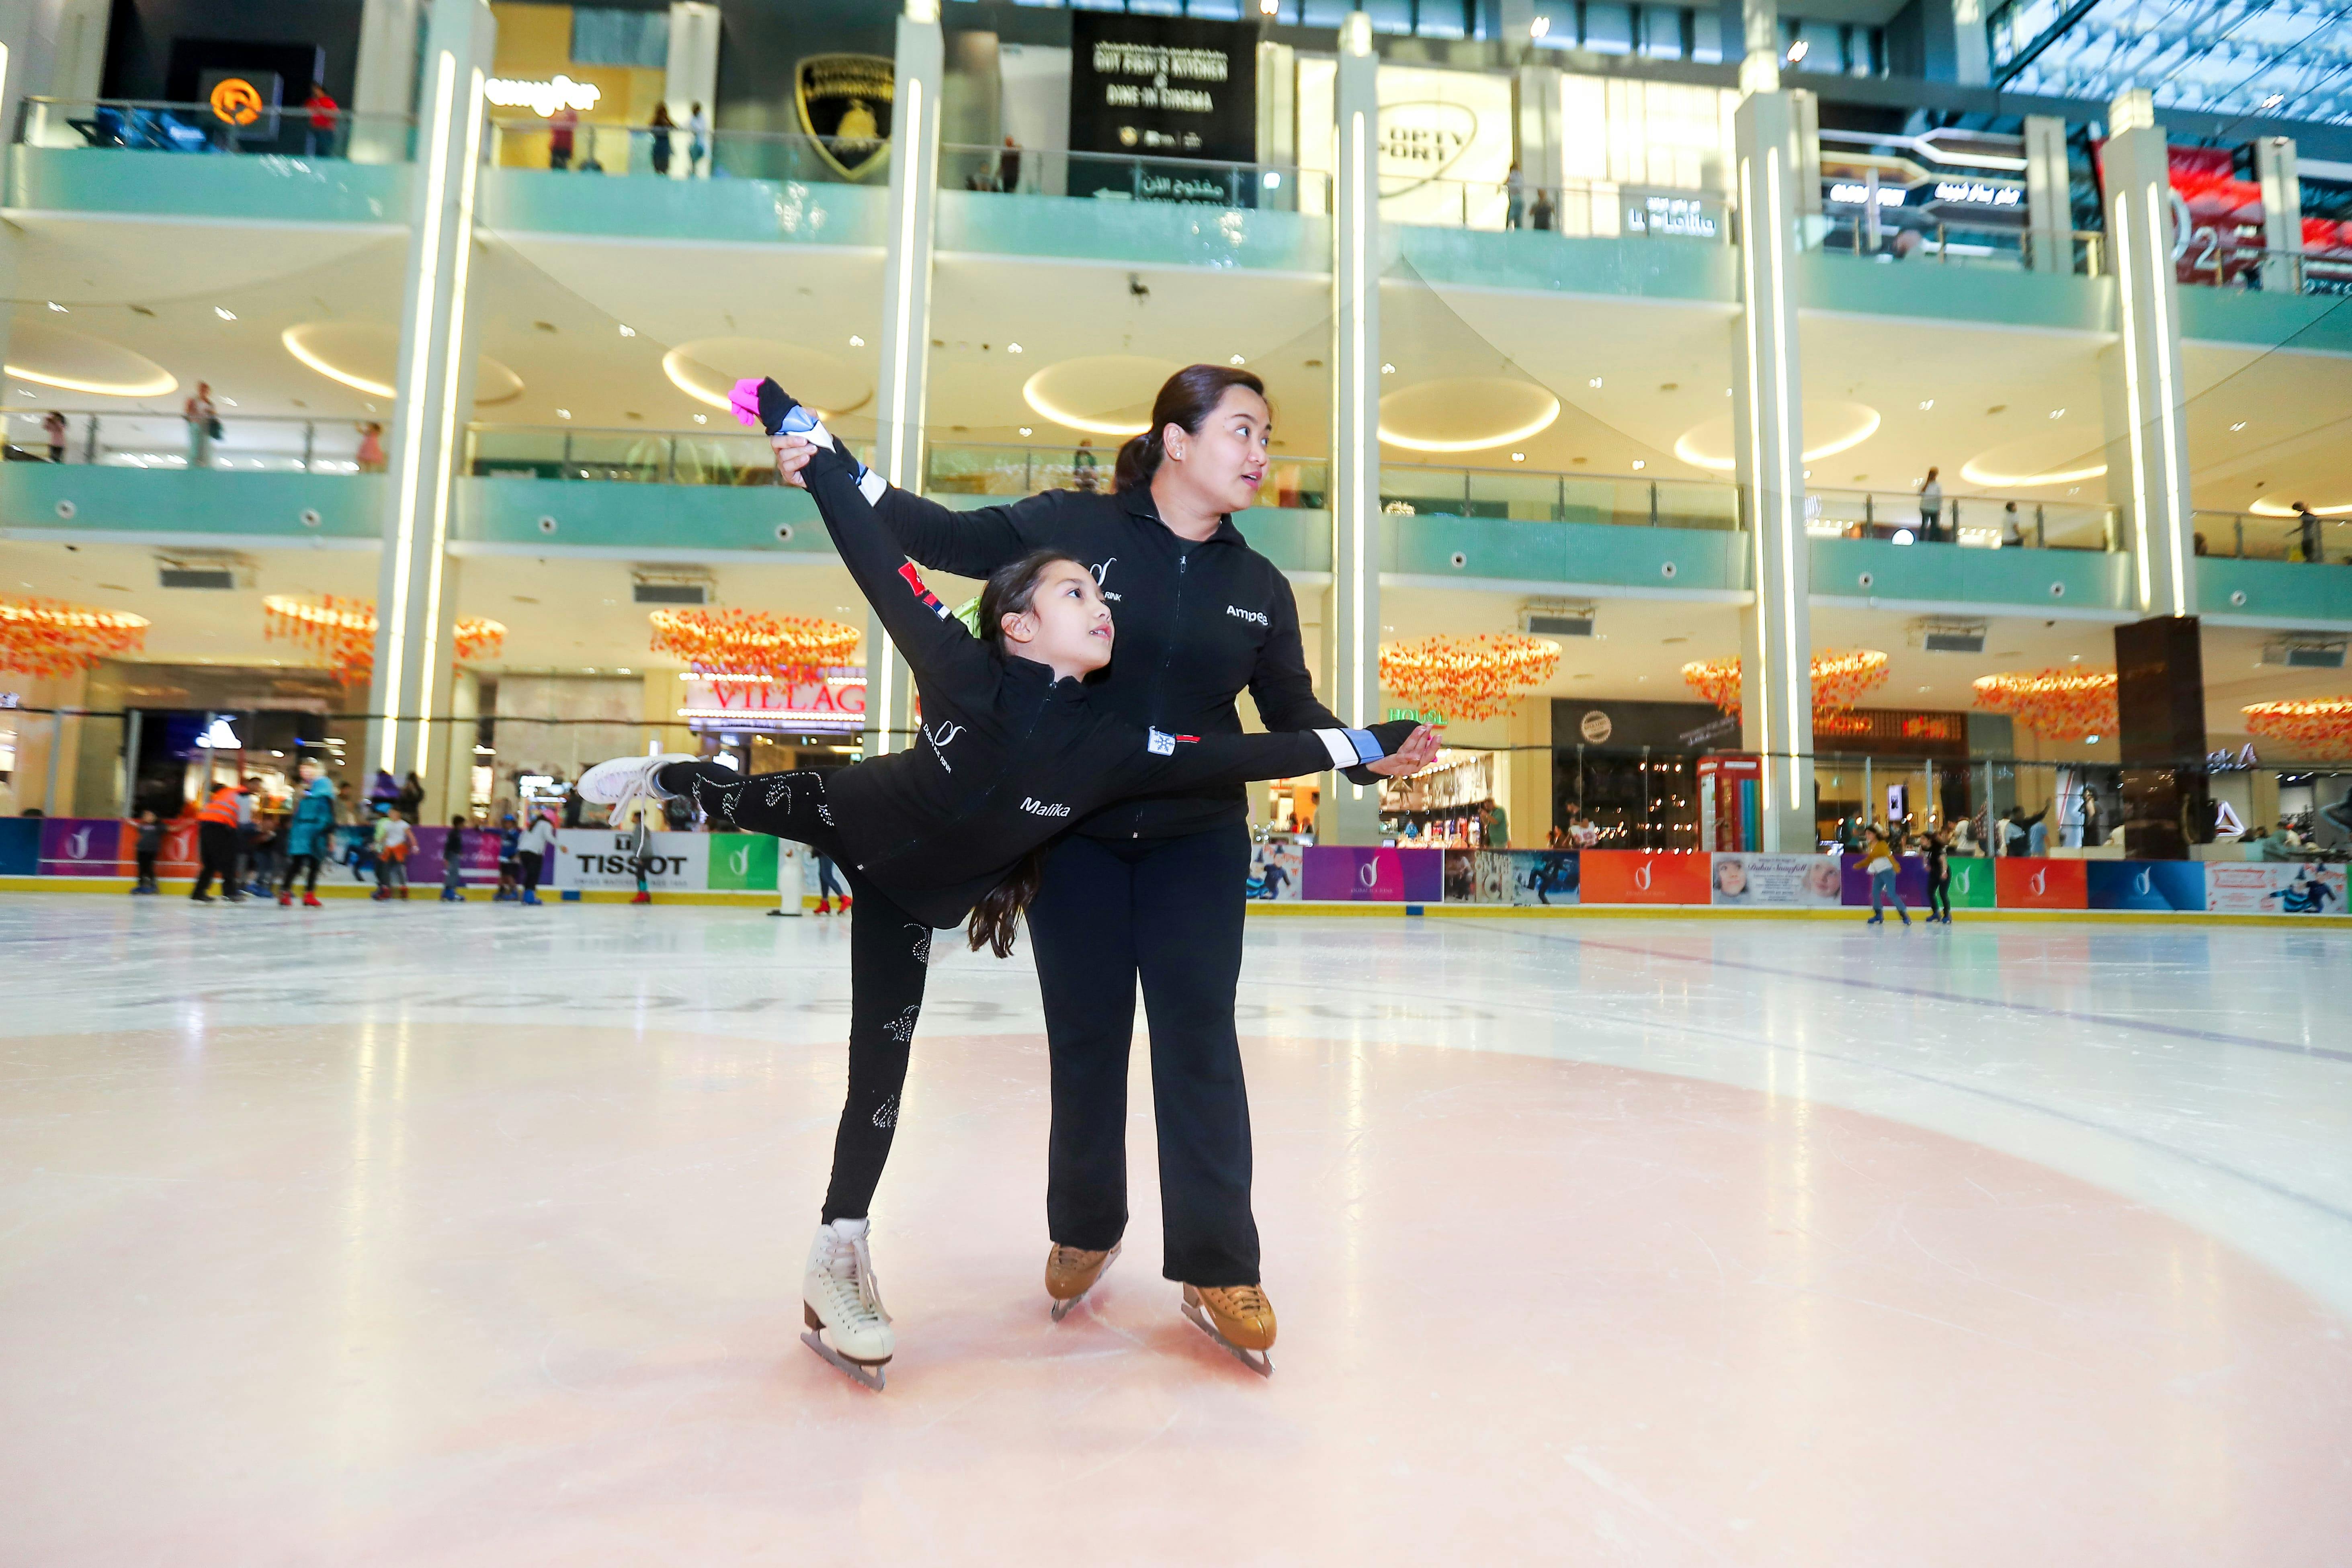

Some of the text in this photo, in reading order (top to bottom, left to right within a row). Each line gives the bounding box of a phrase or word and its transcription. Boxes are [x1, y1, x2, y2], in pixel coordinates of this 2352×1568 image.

[1159, 87, 1214, 113] CINEMA
[1104, 591, 1122, 602] RINK
[1226, 604, 1269, 626] Ampee
[1020, 796, 1071, 817] Malika
[576, 854, 688, 875] TISSOT
[1476, 873, 1514, 903] ICE
